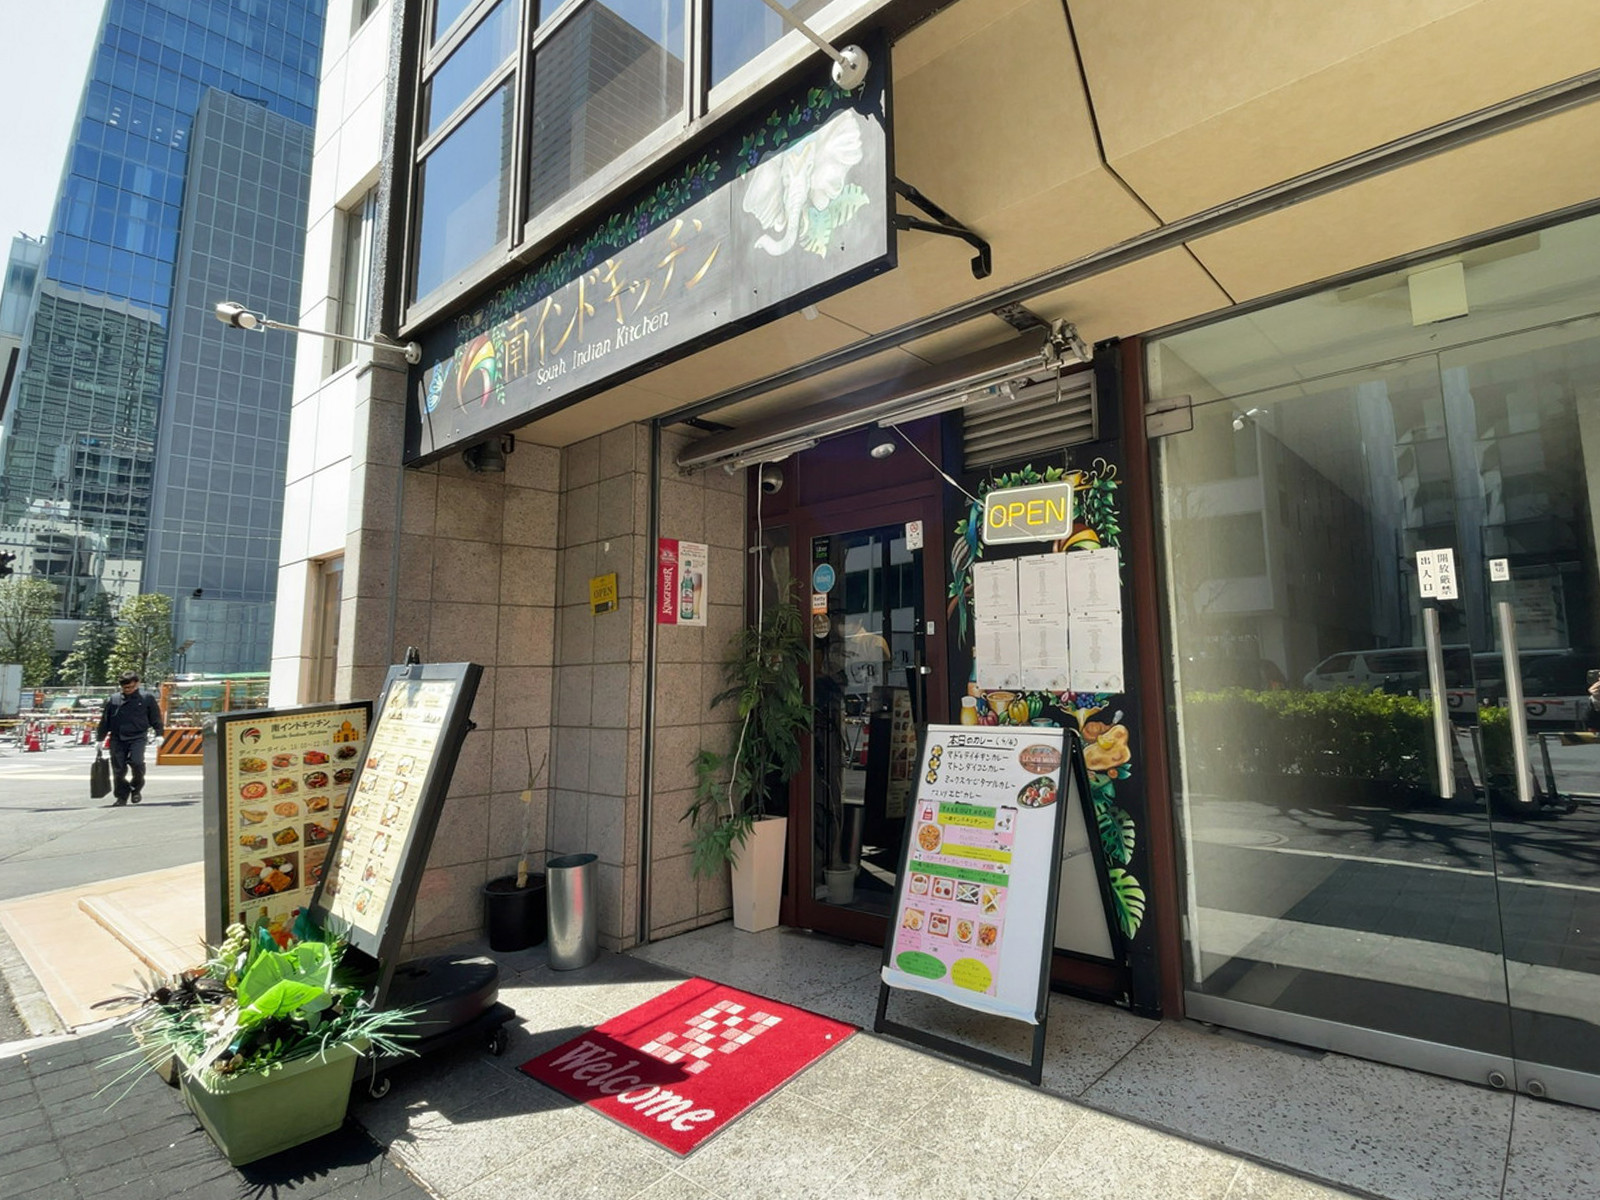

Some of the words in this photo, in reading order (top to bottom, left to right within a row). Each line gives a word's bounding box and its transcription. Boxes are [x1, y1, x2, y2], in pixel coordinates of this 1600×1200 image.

[503, 219, 721, 381] 南インドキッチン
[536, 358, 567, 386] South
[572, 339, 611, 370] Indian
[616, 311, 669, 348] Kitchen
[989, 497, 1065, 529] OPEN
[593, 586, 613, 599] OPEN
[662, 567, 674, 615] KINGFISHER
[1420, 556, 1433, 592] 出入口
[271, 719, 331, 733] 南インドキッチン
[549, 1040, 716, 1133] Welcome
